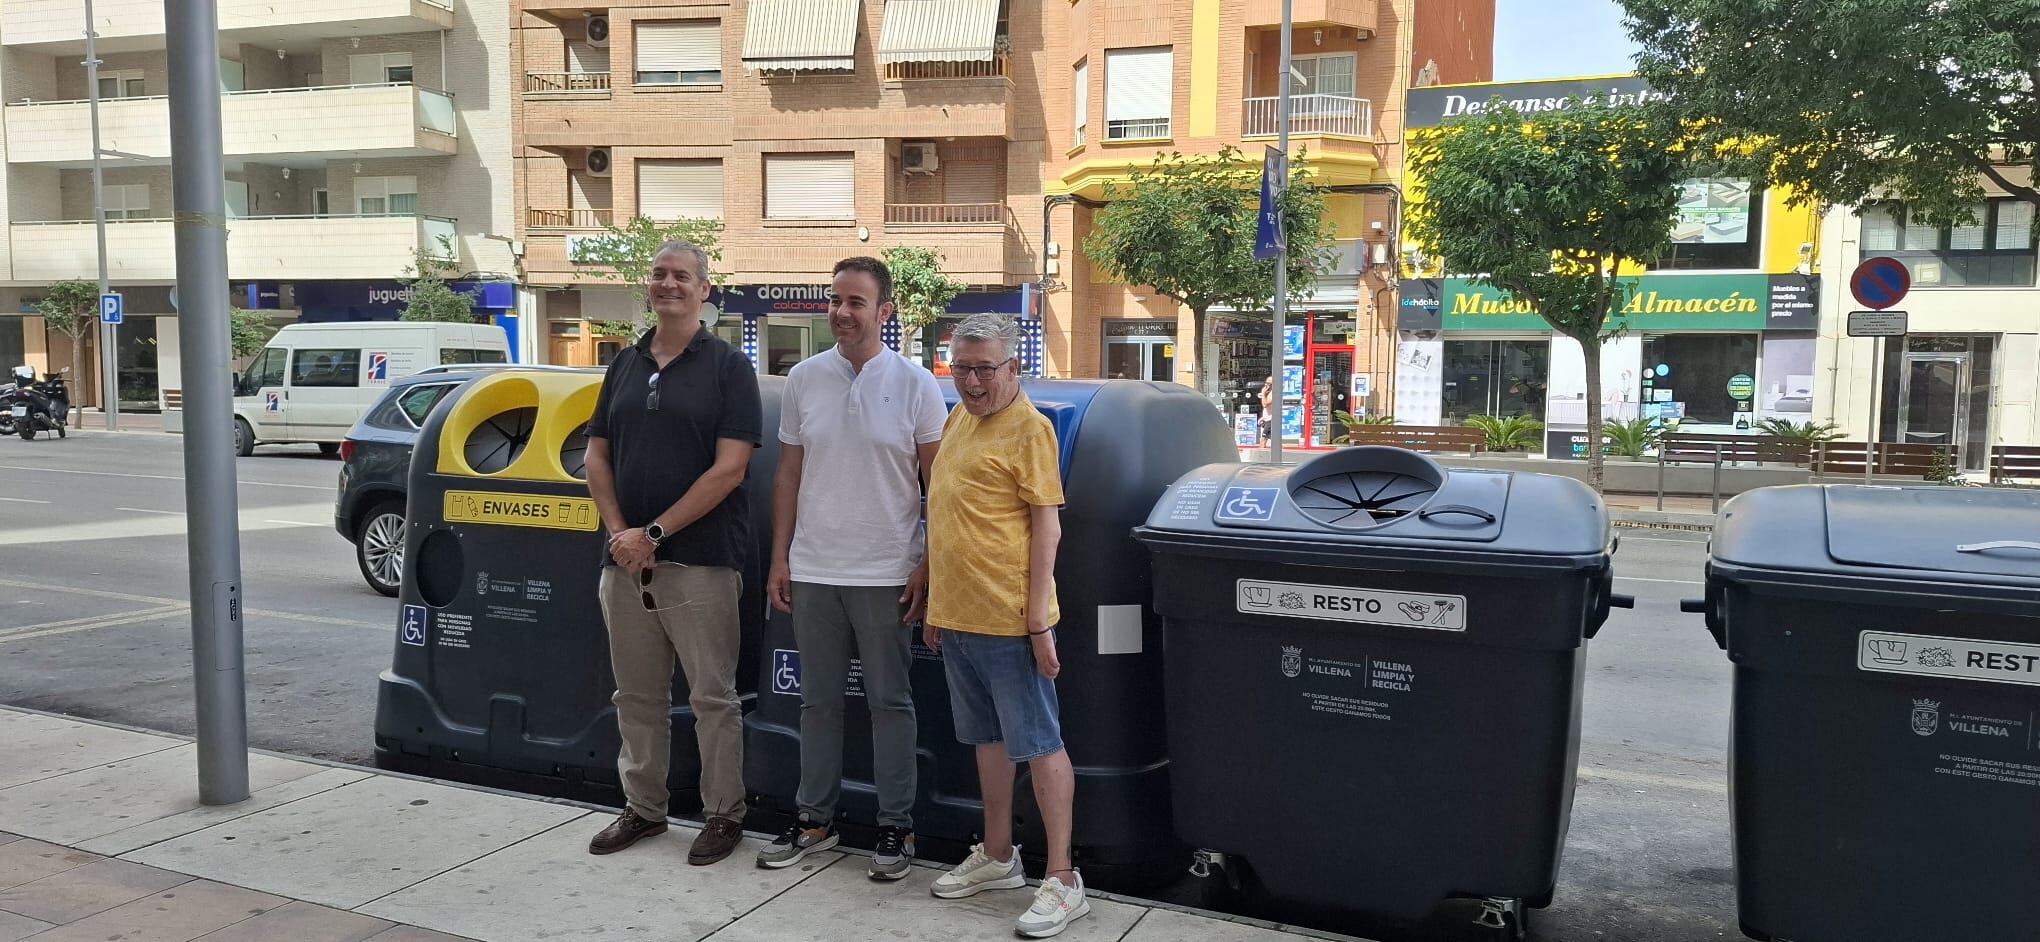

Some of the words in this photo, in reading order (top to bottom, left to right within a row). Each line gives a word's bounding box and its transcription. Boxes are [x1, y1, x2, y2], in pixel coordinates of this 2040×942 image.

[105, 297, 117, 321] P
[1620, 290, 1758, 314] Almacén
[482, 500, 550, 517] ENVASES
[1313, 594, 1382, 614] RESTO
[1372, 660, 1413, 673] VILLENA
[1966, 650, 2039, 673] REST
[1308, 664, 1352, 678] VILLENA
[1372, 670, 1406, 682] LIMPIA
[1408, 674, 1415, 682] Y
[1371, 679, 1411, 692] RECICLA
[1949, 721, 2009, 737] VILLENA
[1952, 755, 1977, 764] OLVIDE
[1979, 759, 2004, 767] SACAR
